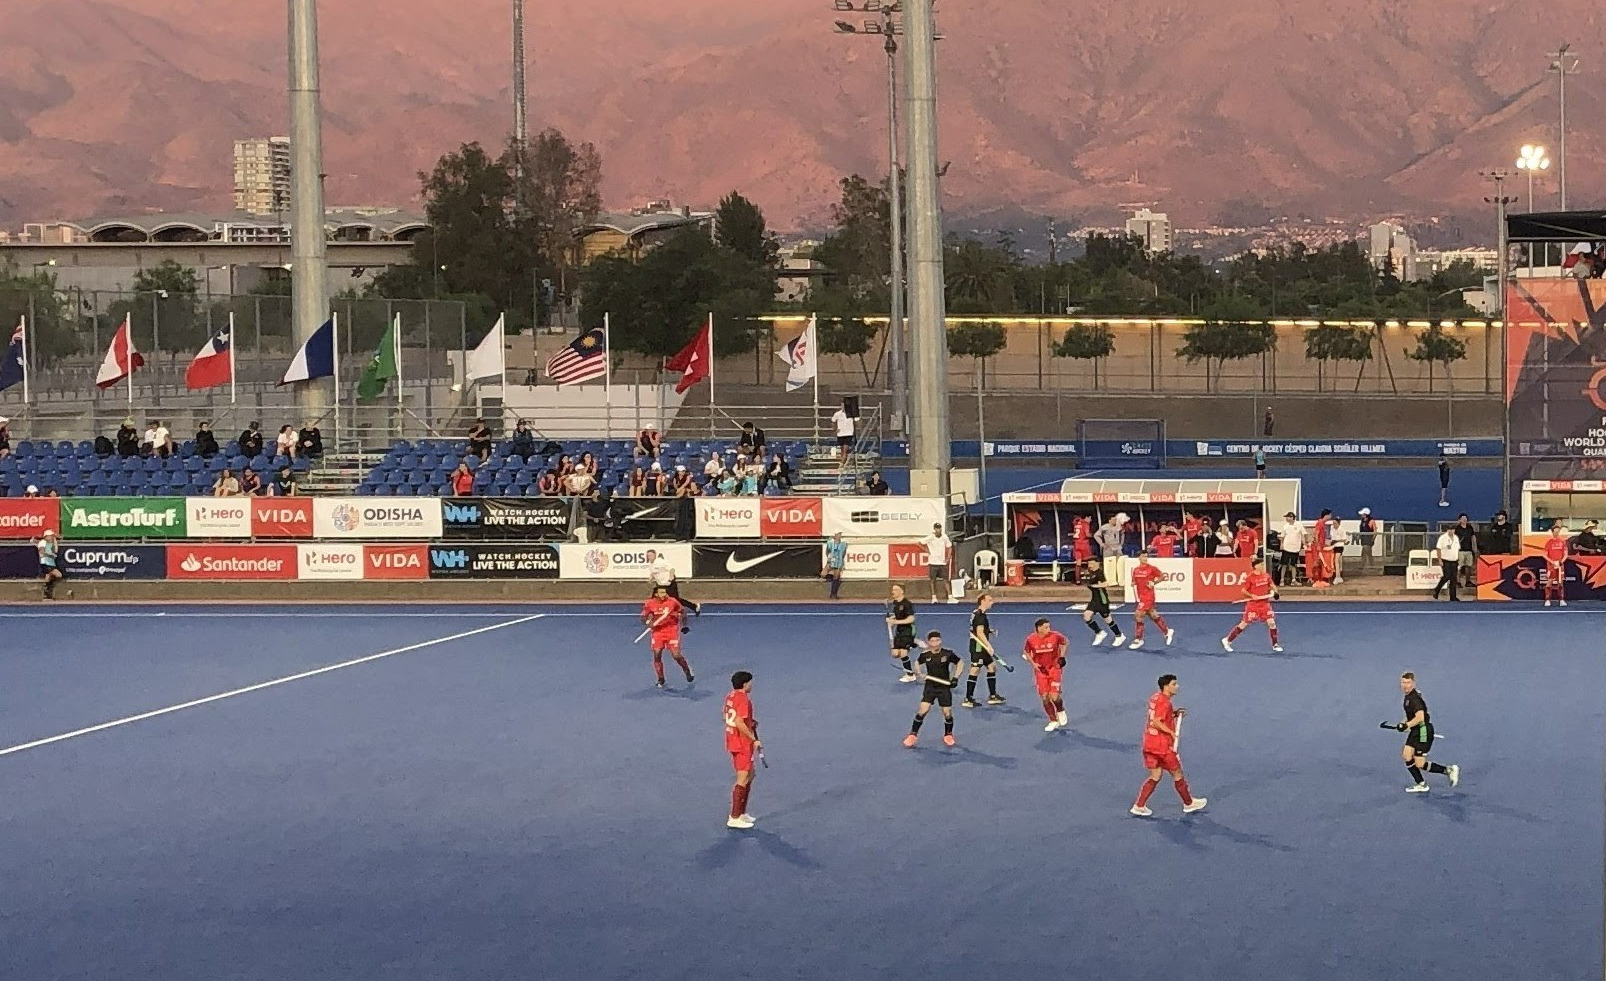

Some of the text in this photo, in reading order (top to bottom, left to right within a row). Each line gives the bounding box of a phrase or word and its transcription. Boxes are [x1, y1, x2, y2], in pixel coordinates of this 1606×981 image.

[1563, 437, 1605, 447] WORLD
[1152, 494, 1174, 502] VIDA
[0, 512, 46, 527] ander
[210, 508, 244, 520] Hero
[258, 509, 307, 523] VIDA
[364, 508, 424, 521] ODISHA
[720, 509, 753, 520] Hero
[766, 509, 816, 524] VIDA
[484, 516, 566, 526] LIVE THE ACTION
[64, 548, 126, 566] Cuprum
[322, 553, 356, 564] Hero
[370, 553, 420, 568] VIDA
[846, 552, 882, 563] Hero
[896, 552, 930, 567] VID
[203, 556, 284, 572] Santander
[473, 560, 558, 570] LIVE THE ACTION
